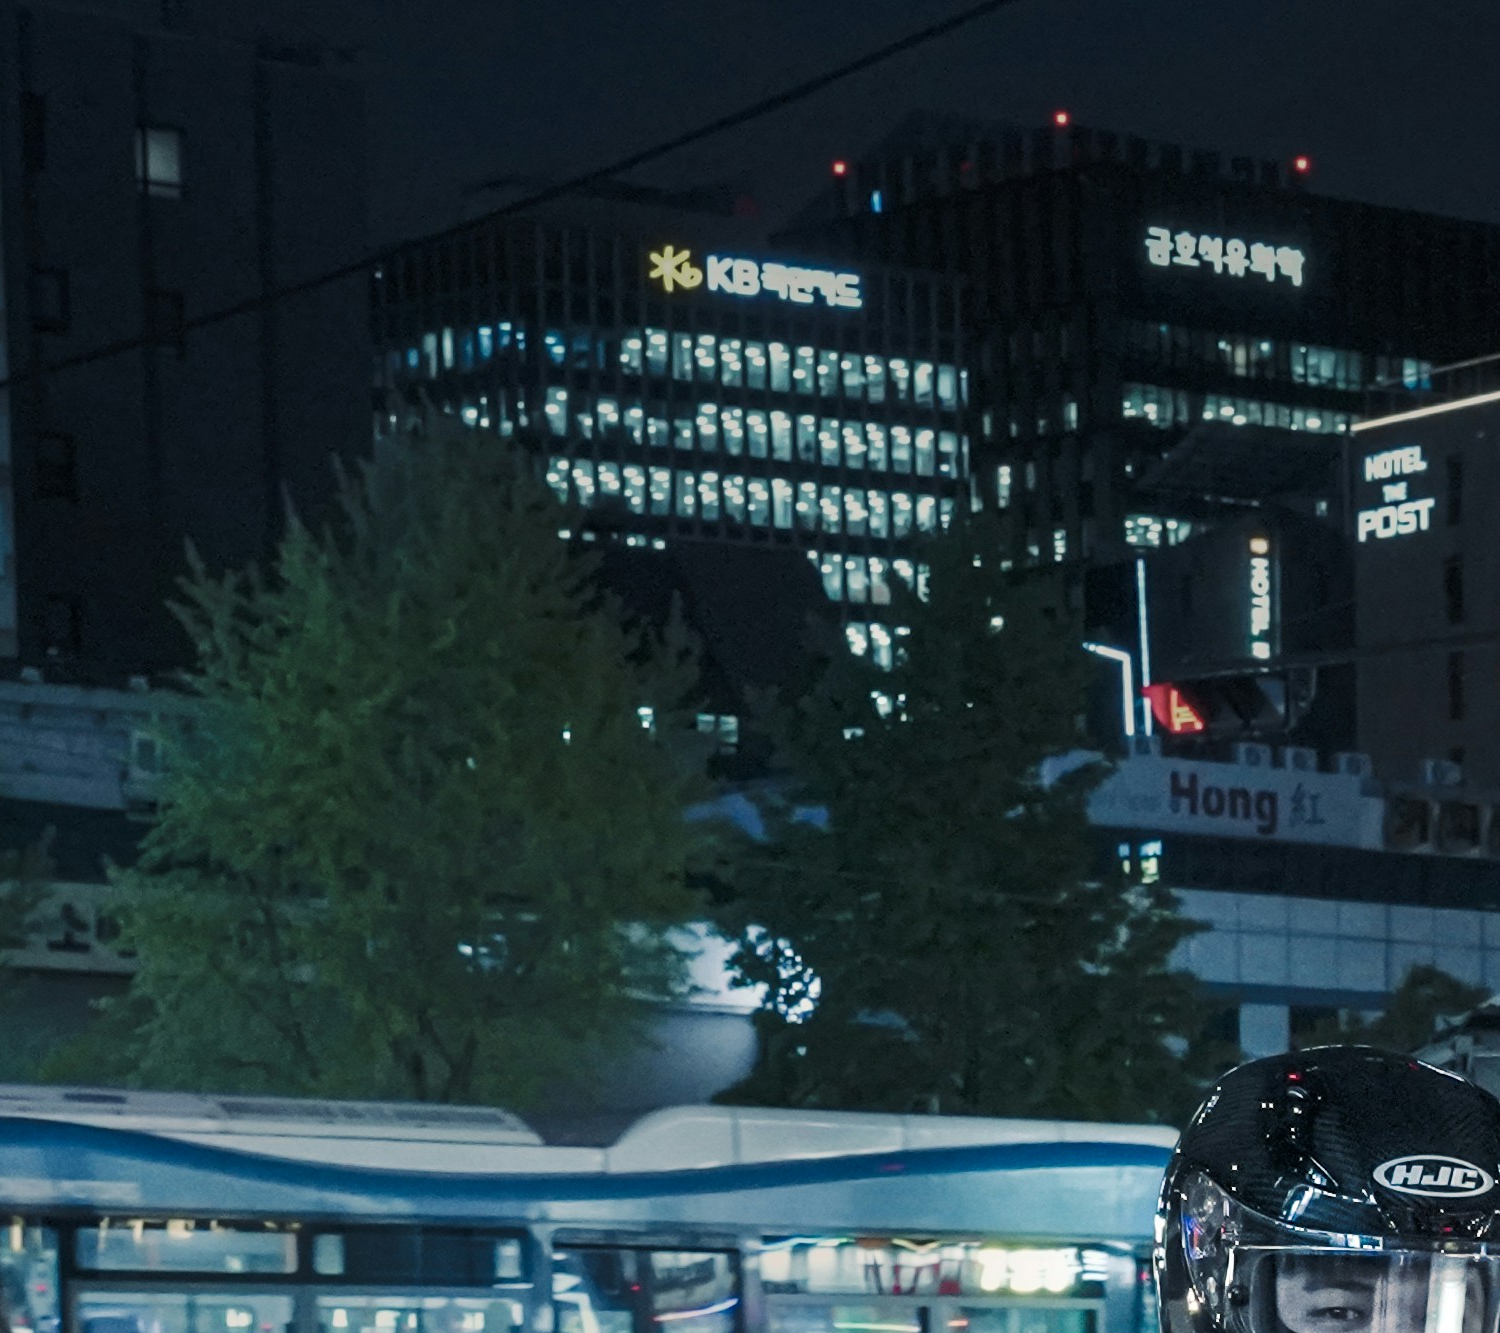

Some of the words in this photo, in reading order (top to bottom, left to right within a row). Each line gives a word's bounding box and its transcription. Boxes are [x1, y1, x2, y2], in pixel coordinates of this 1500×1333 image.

[1145, 226, 1305, 286] 금호석유화학
[1364, 445, 1428, 482] HOTEL
[1358, 497, 1436, 542] POST
[1169, 770, 1280, 835] Hong
[1390, 1164, 1479, 1190] HJC
